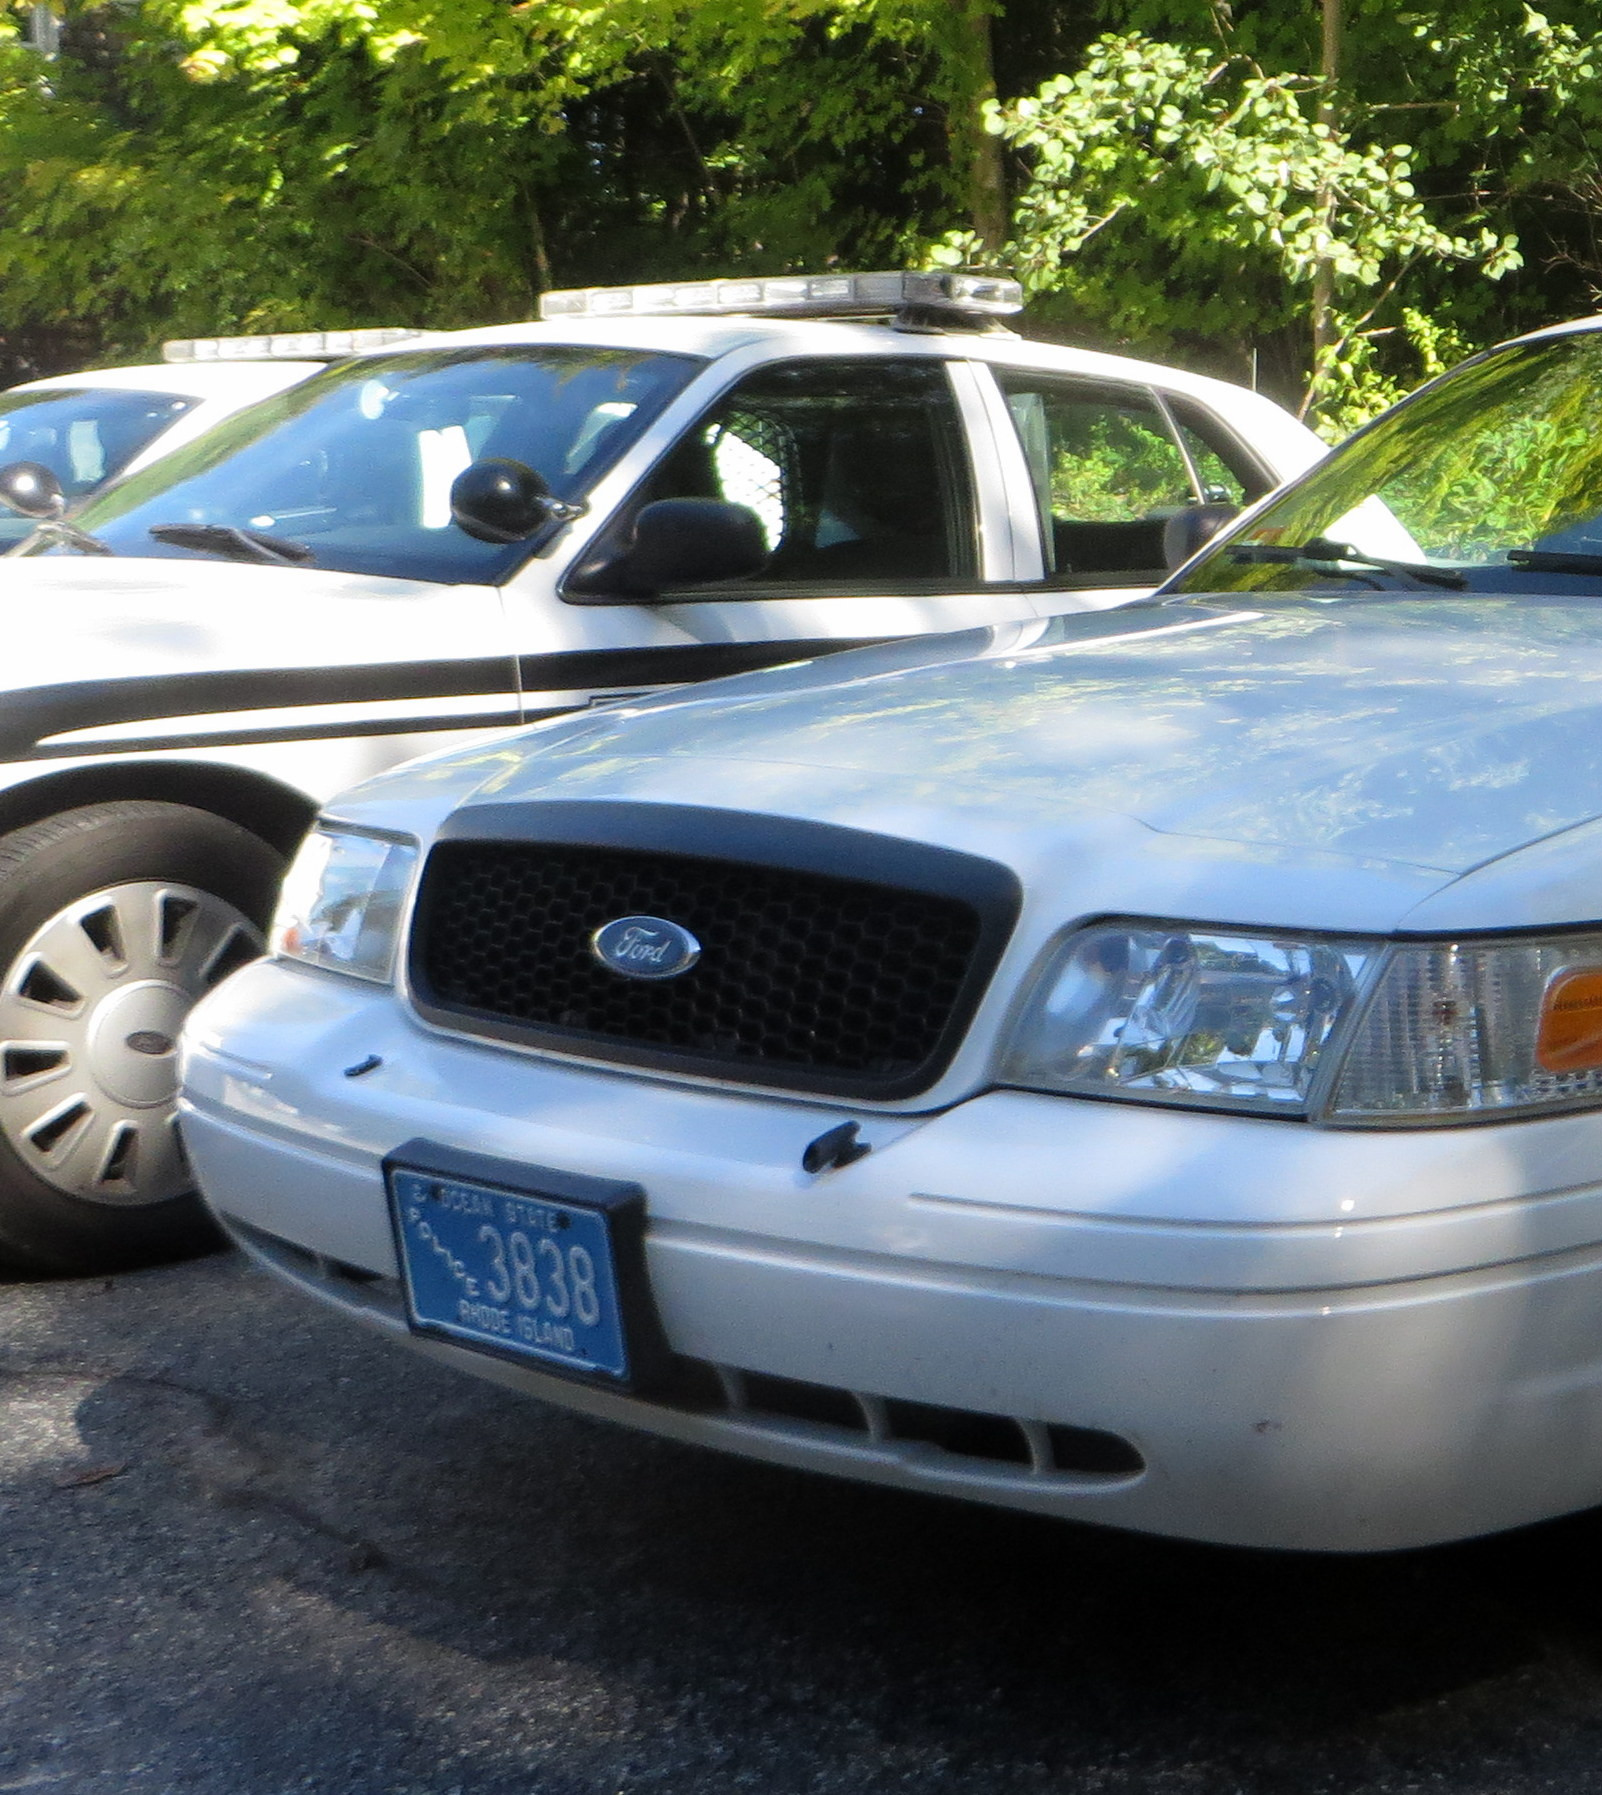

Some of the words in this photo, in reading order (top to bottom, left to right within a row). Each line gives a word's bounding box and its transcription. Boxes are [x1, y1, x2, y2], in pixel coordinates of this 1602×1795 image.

[615, 926, 672, 963] Ford
[479, 1224, 600, 1326] 3838
[457, 1299, 511, 1334] RHODE
[517, 1315, 575, 1351] ISLAND
